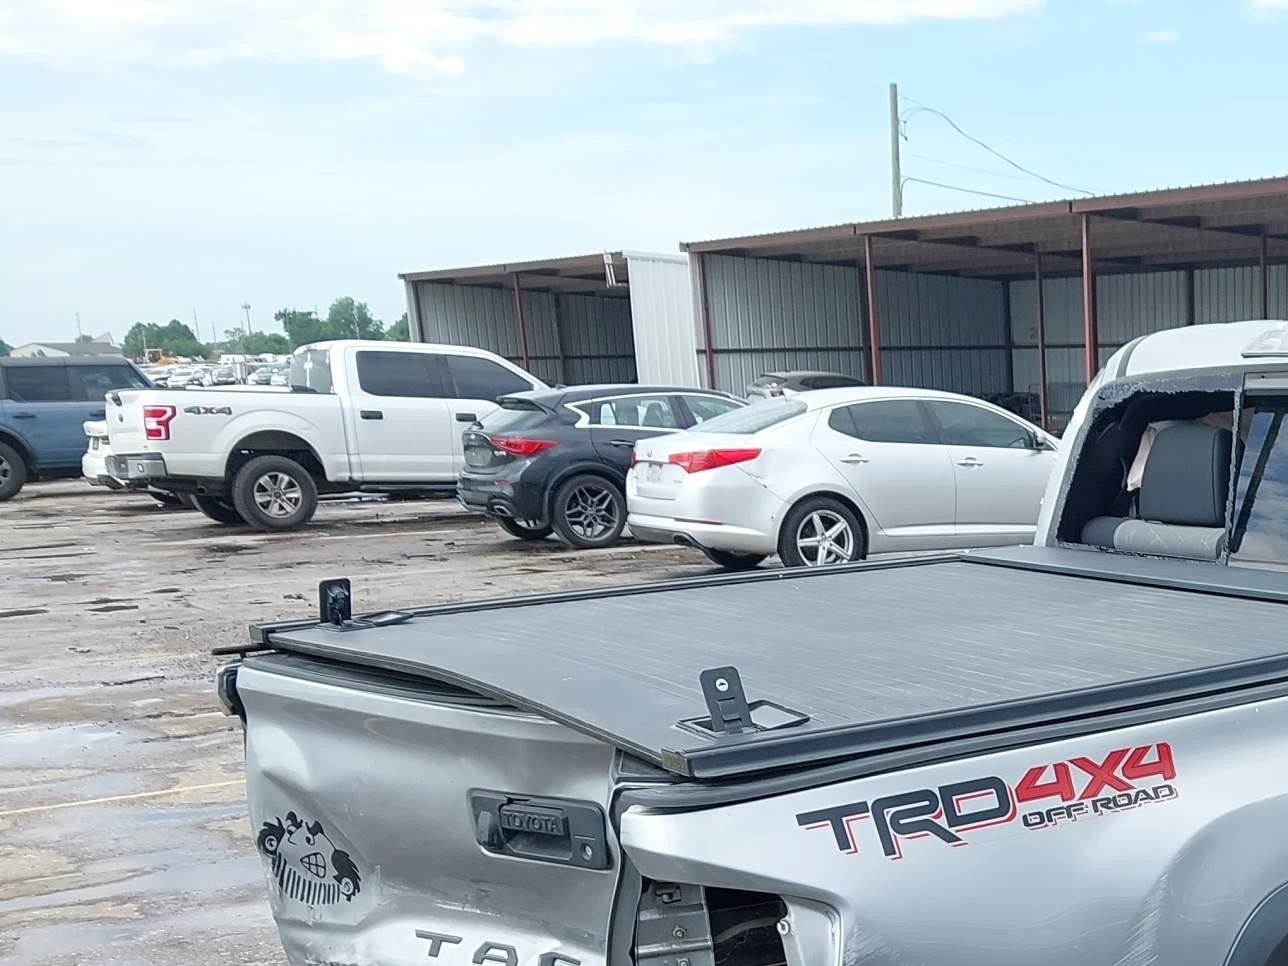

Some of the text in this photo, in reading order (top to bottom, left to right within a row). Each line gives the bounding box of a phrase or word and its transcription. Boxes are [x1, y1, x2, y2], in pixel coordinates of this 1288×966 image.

[503, 811, 565, 834] TOYOTA
[795, 742, 1177, 861] TRD 4X4
[1022, 784, 1178, 831] OFF ROAD
